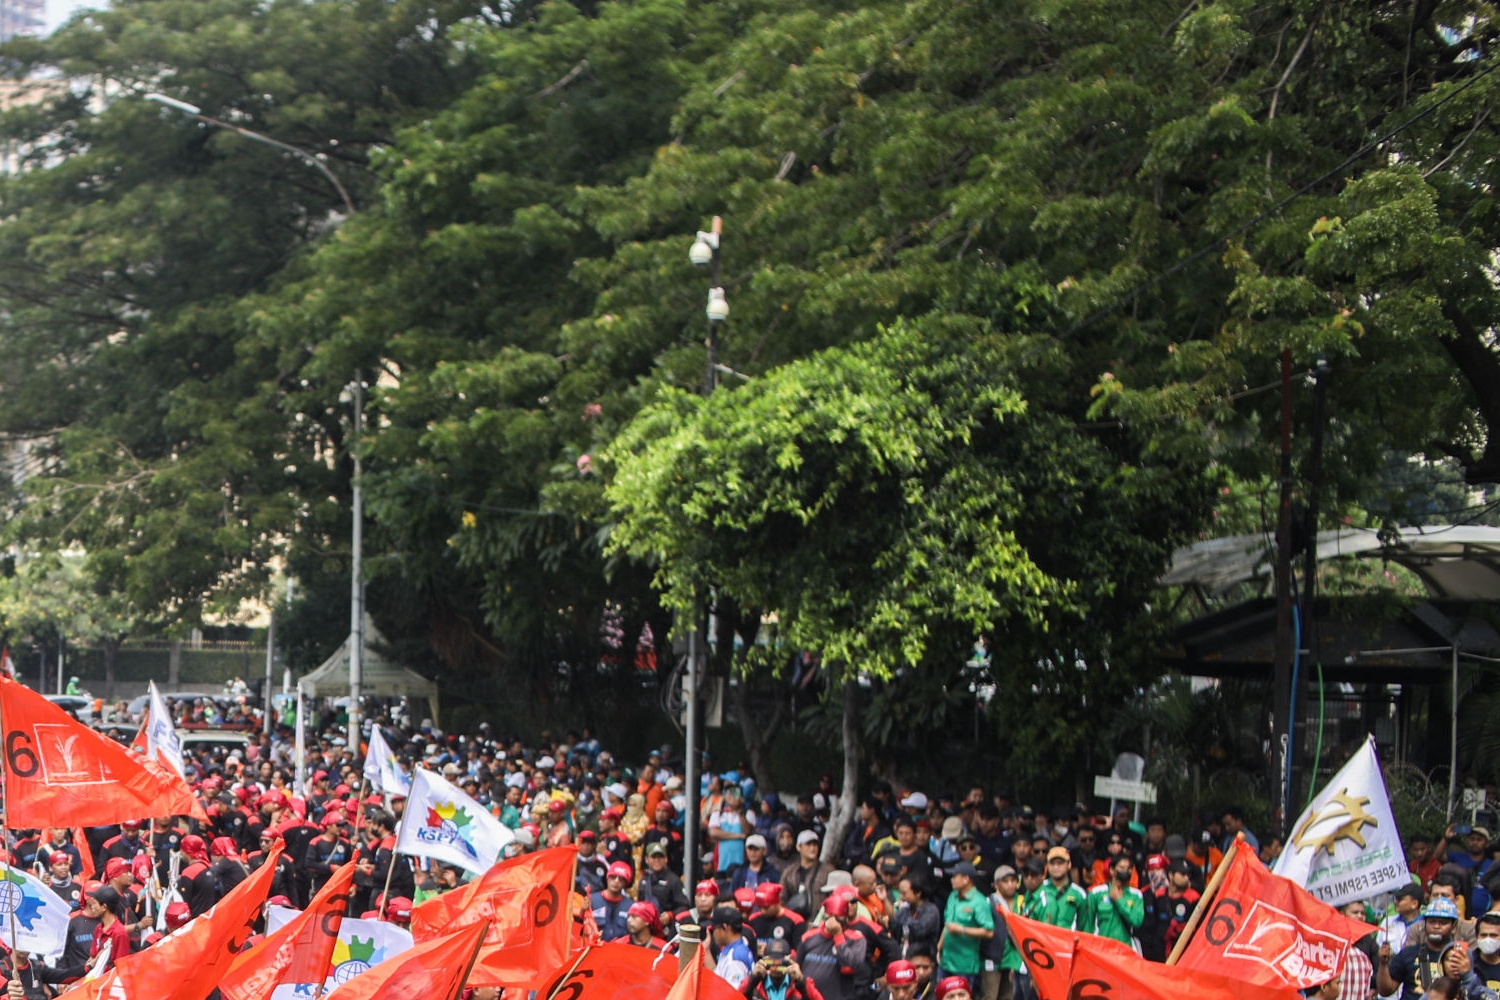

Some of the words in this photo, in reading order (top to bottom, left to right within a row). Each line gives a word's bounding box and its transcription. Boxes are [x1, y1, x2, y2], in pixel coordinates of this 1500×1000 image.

[6, 730, 39, 778] 6
[1205, 898, 1243, 947] 6
[1022, 938, 1055, 970] 6
